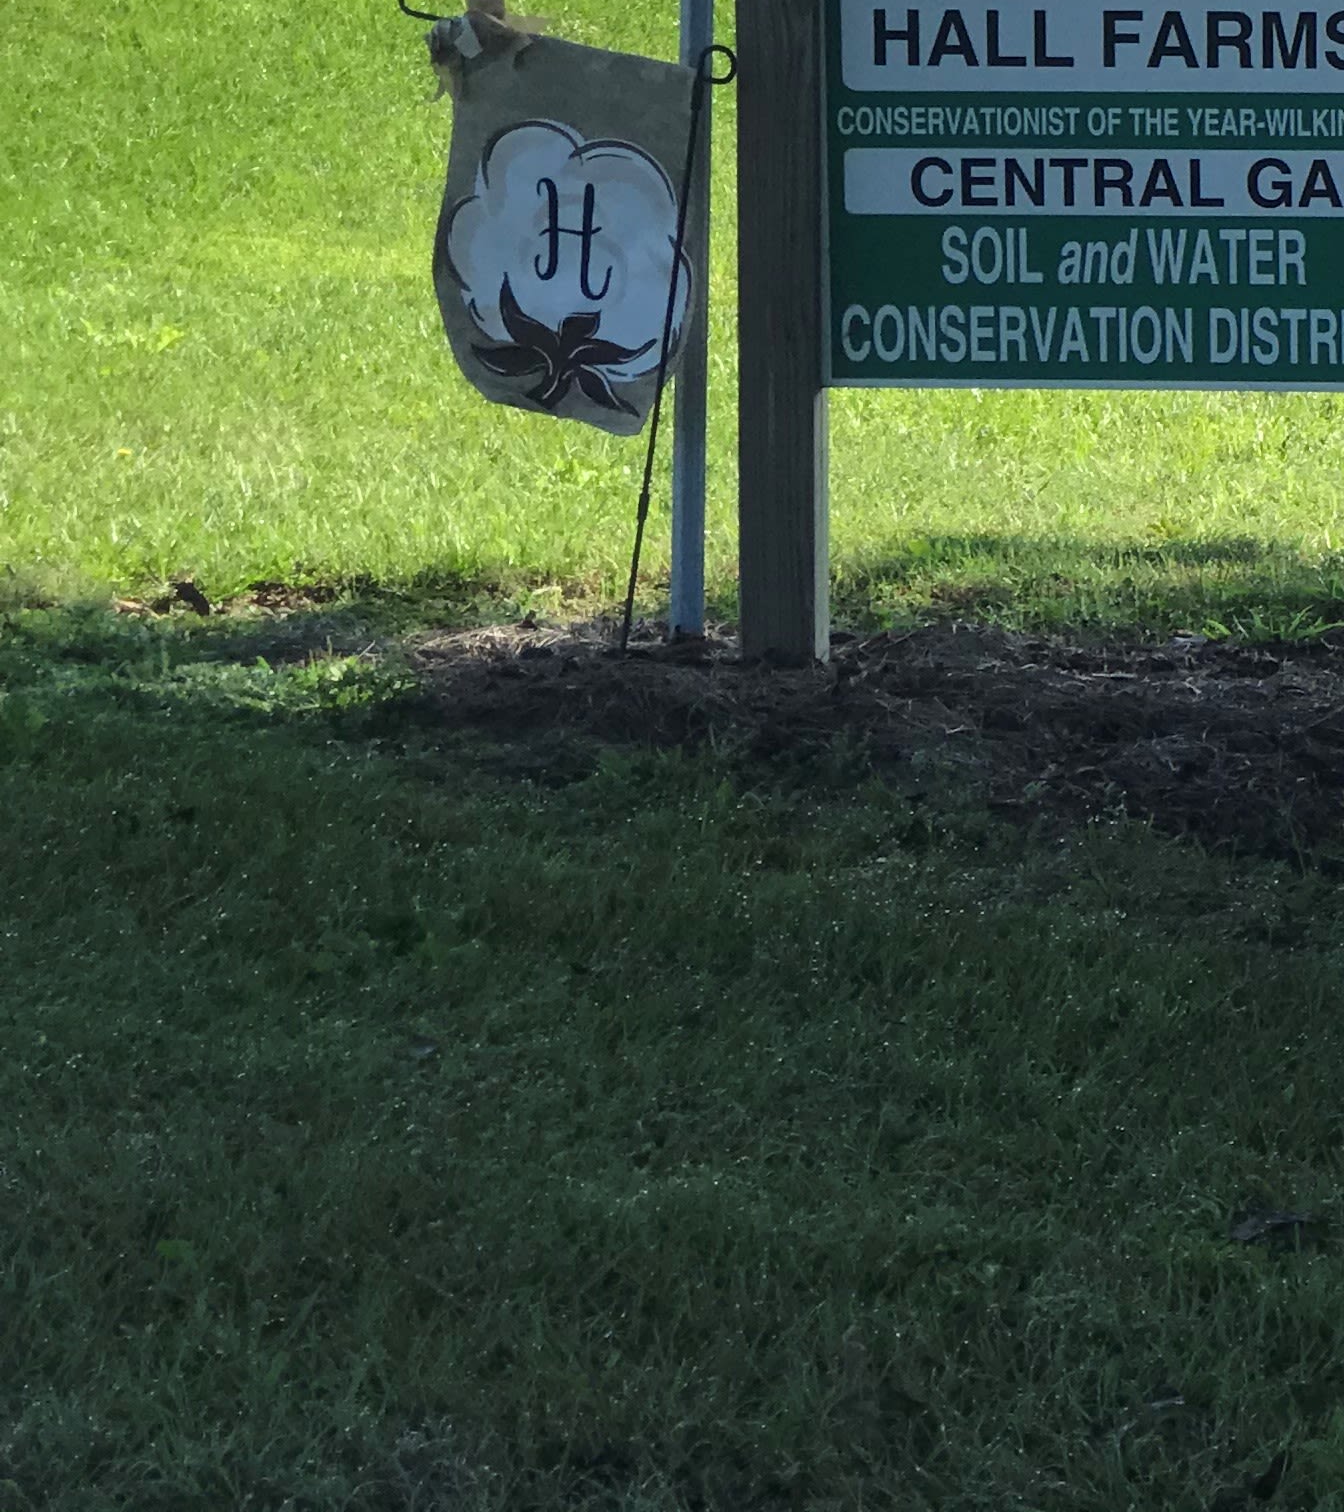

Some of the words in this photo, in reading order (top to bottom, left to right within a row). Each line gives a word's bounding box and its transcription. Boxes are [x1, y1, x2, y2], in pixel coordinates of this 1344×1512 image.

[872, 8, 1075, 68] HALL
[836, 106, 1081, 137] CONSERVATIONIST
[1086, 107, 1123, 137] OF
[1128, 107, 1180, 137] THE
[909, 156, 1225, 209] CENTRAL
[1246, 157, 1344, 209] GA
[534, 177, 613, 301] H
[940, 225, 1044, 286] SOIL
[1057, 228, 1139, 287] and
[1146, 228, 1308, 287] WATER
[840, 303, 1195, 365] CONSERVATION
